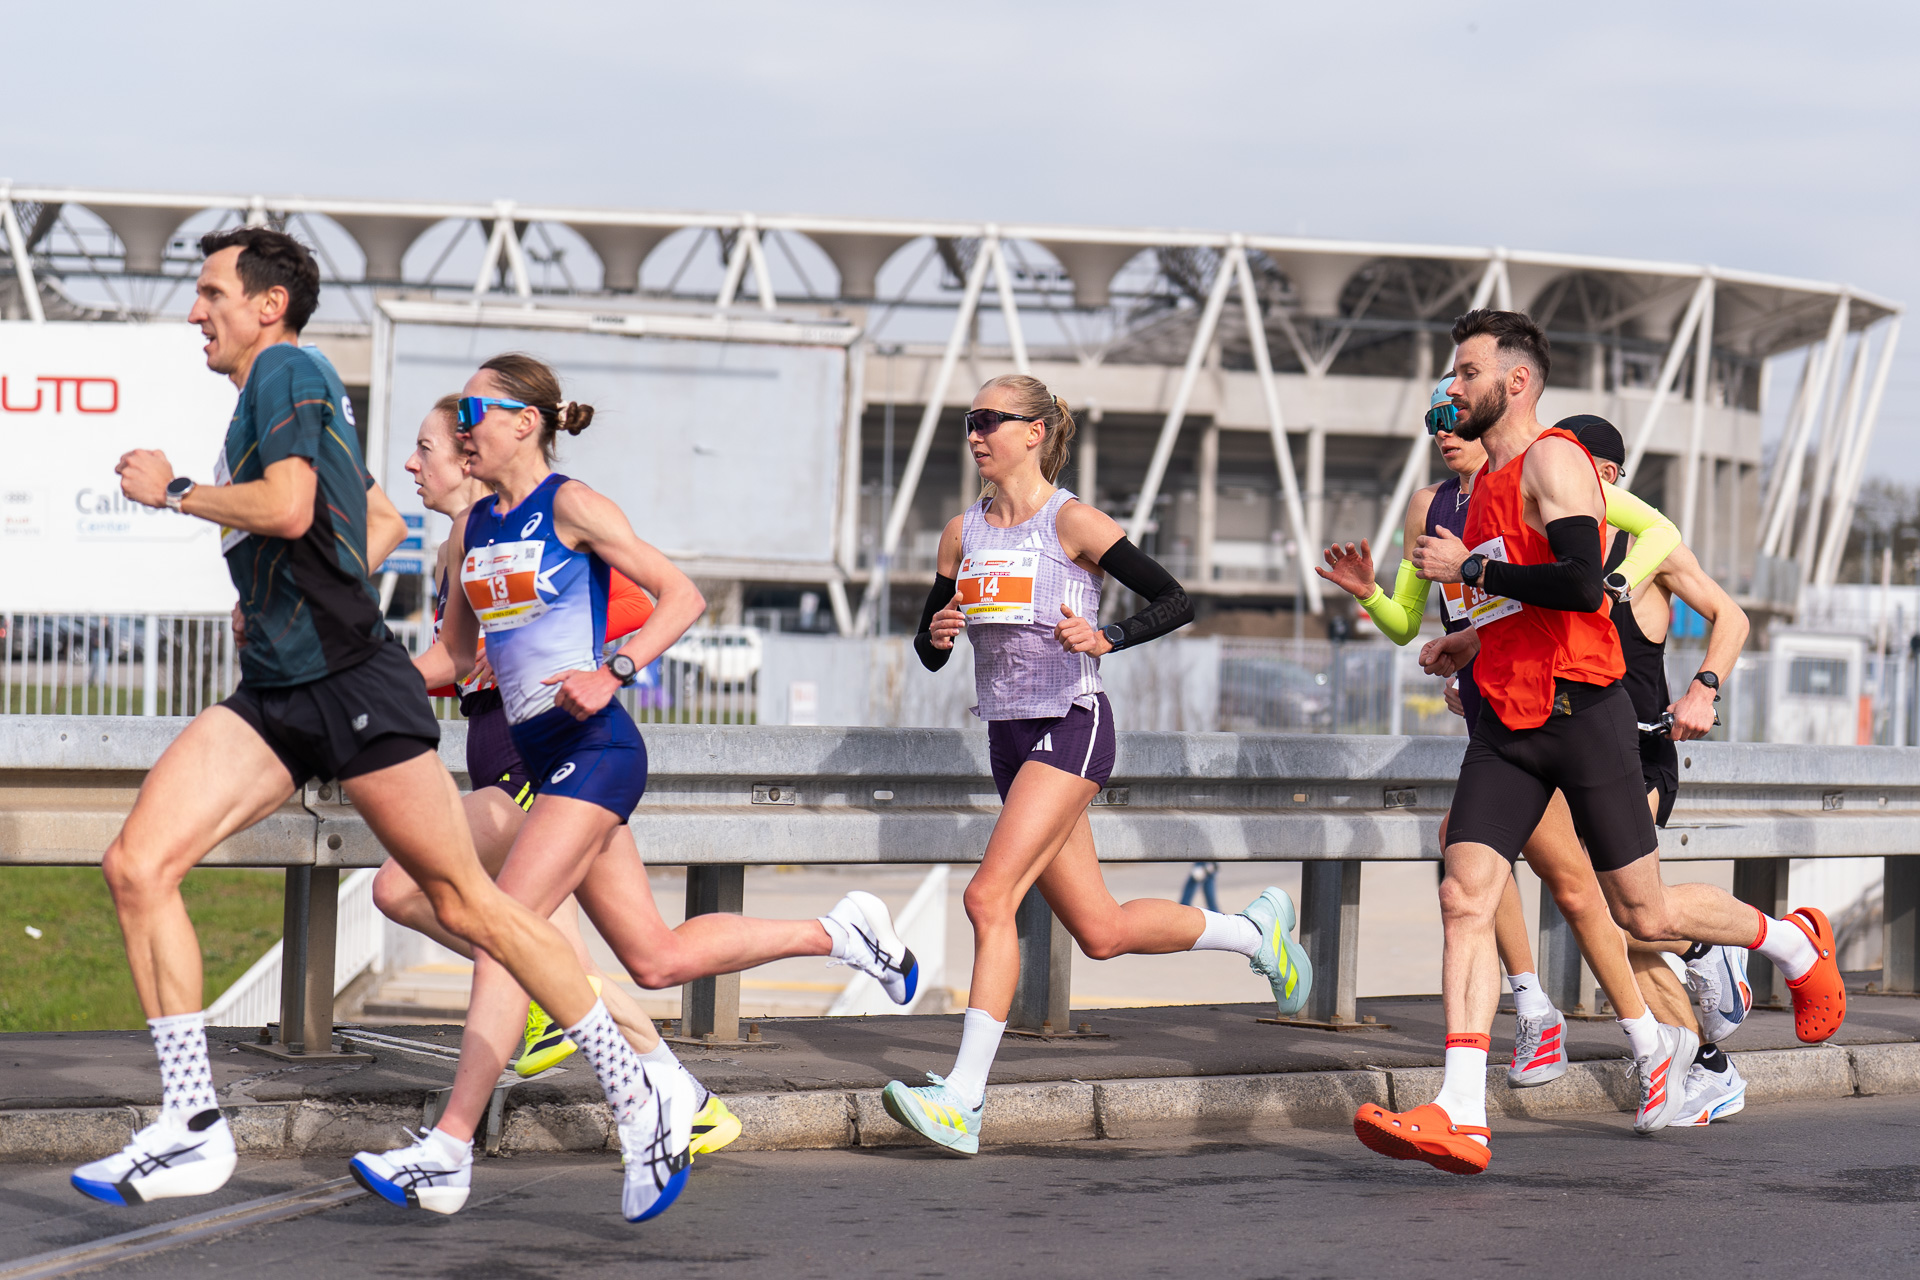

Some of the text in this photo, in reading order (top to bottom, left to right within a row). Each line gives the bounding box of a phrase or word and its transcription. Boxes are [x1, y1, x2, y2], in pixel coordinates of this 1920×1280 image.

[2, 375, 119, 414] UTO
[487, 575, 509, 600] 13
[977, 577, 1000, 597] 14
[1469, 586, 1494, 605] 33
